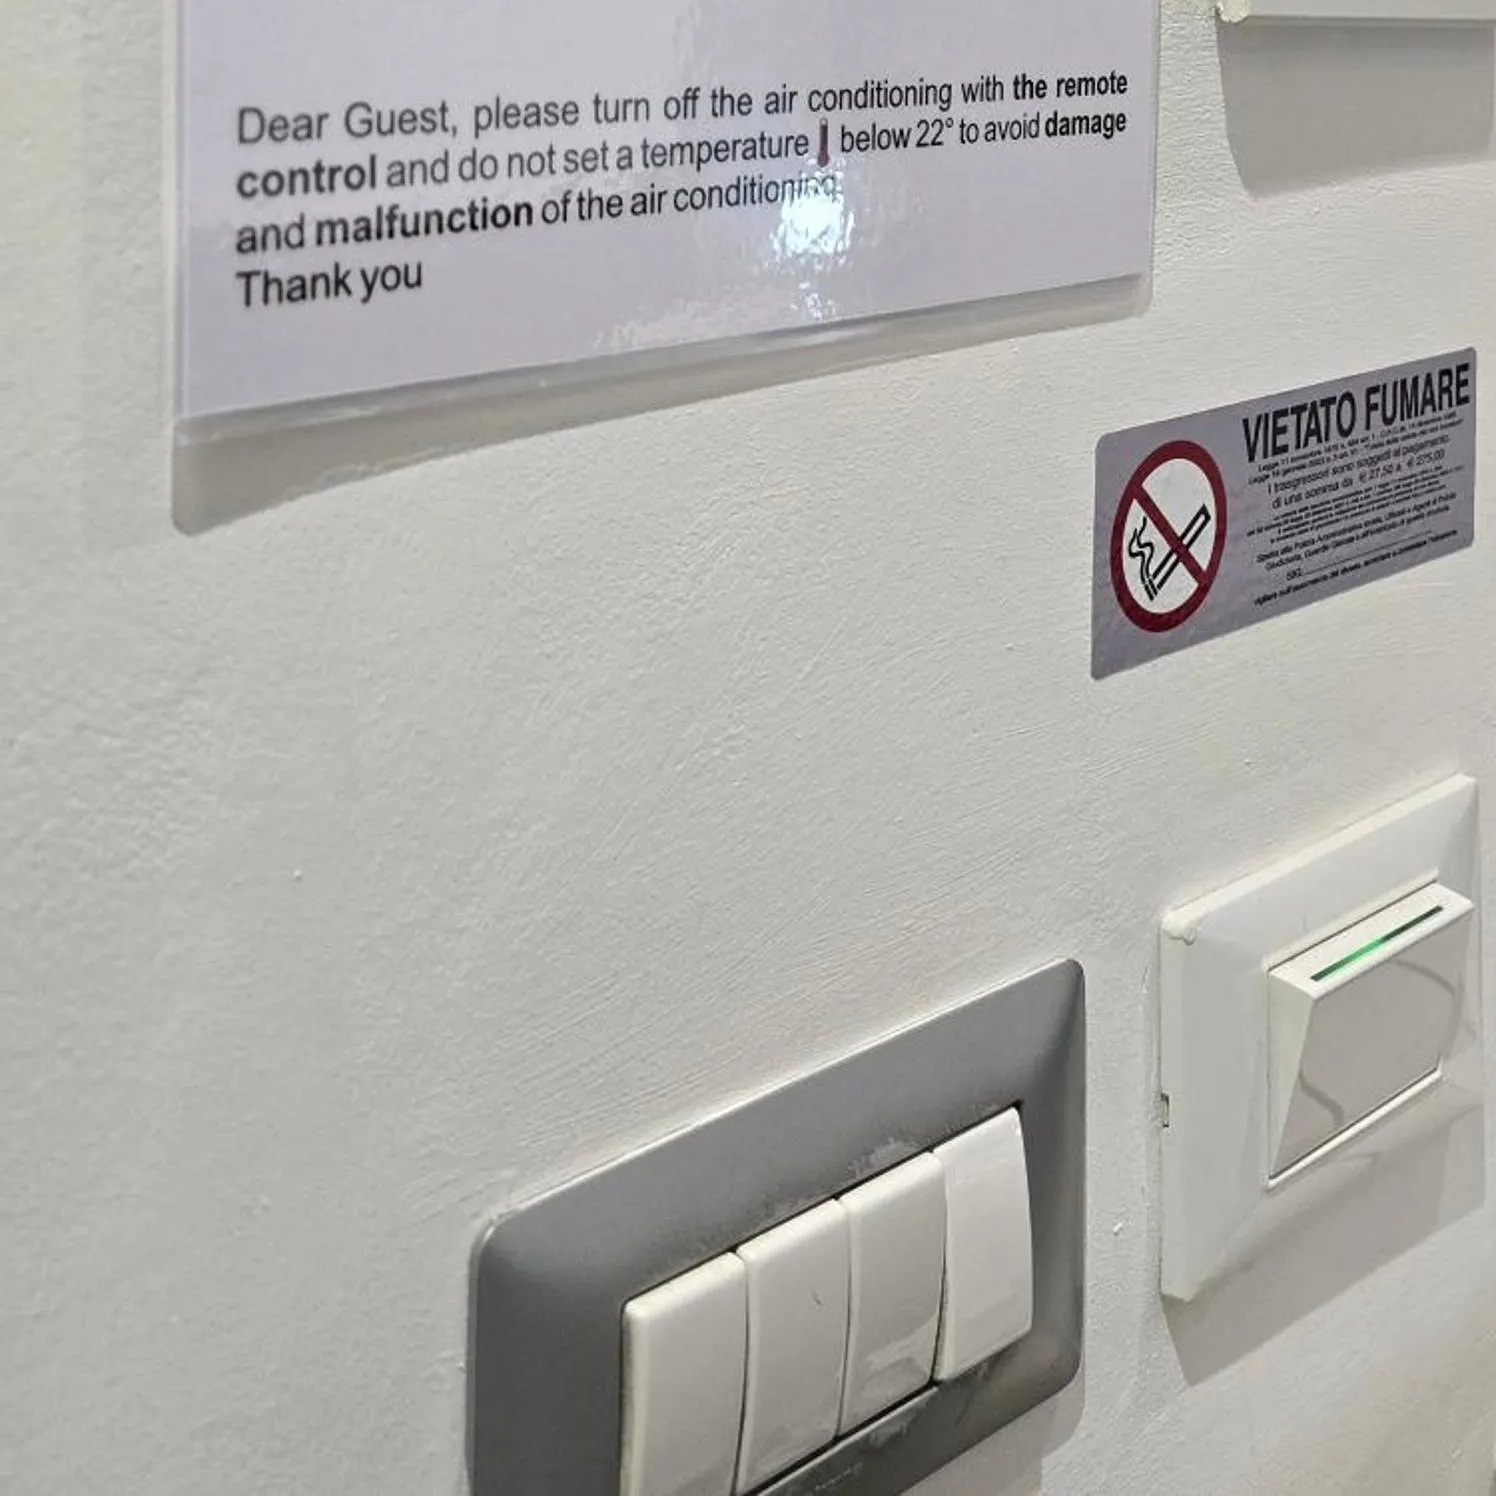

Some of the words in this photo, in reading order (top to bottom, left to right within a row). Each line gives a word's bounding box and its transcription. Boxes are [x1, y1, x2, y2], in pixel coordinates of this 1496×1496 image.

[237, 106, 331, 145] Dear
[343, 99, 458, 139] Guest,
[473, 95, 580, 140] please
[592, 92, 651, 125] turn
[663, 86, 701, 122] off
[709, 85, 754, 119] the
[763, 83, 799, 116] air
[807, 77, 953, 113] conditioning
[960, 73, 1005, 105] with
[1012, 71, 1049, 101] the
[1055, 69, 1128, 99] remote
[235, 153, 377, 200] control
[385, 149, 450, 189] and
[457, 147, 499, 183] do
[507, 143, 557, 179] not
[563, 140, 610, 175] set
[615, 145, 634, 171] a
[640, 130, 810, 173] temperature
[840, 121, 913, 154] below
[914, 116, 955, 149] 22°
[958, 117, 980, 145] to
[983, 111, 1041, 143] avoid
[1044, 109, 1128, 141] damage
[235, 212, 306, 256] and
[315, 196, 534, 248] malfunction
[540, 189, 573, 225] of
[576, 187, 624, 222] the
[629, 182, 669, 217] air
[234, 261, 353, 309] Thank
[359, 261, 423, 306] you
[1243, 391, 1356, 463] VIETATO
[1365, 363, 1470, 430] FUMARE
